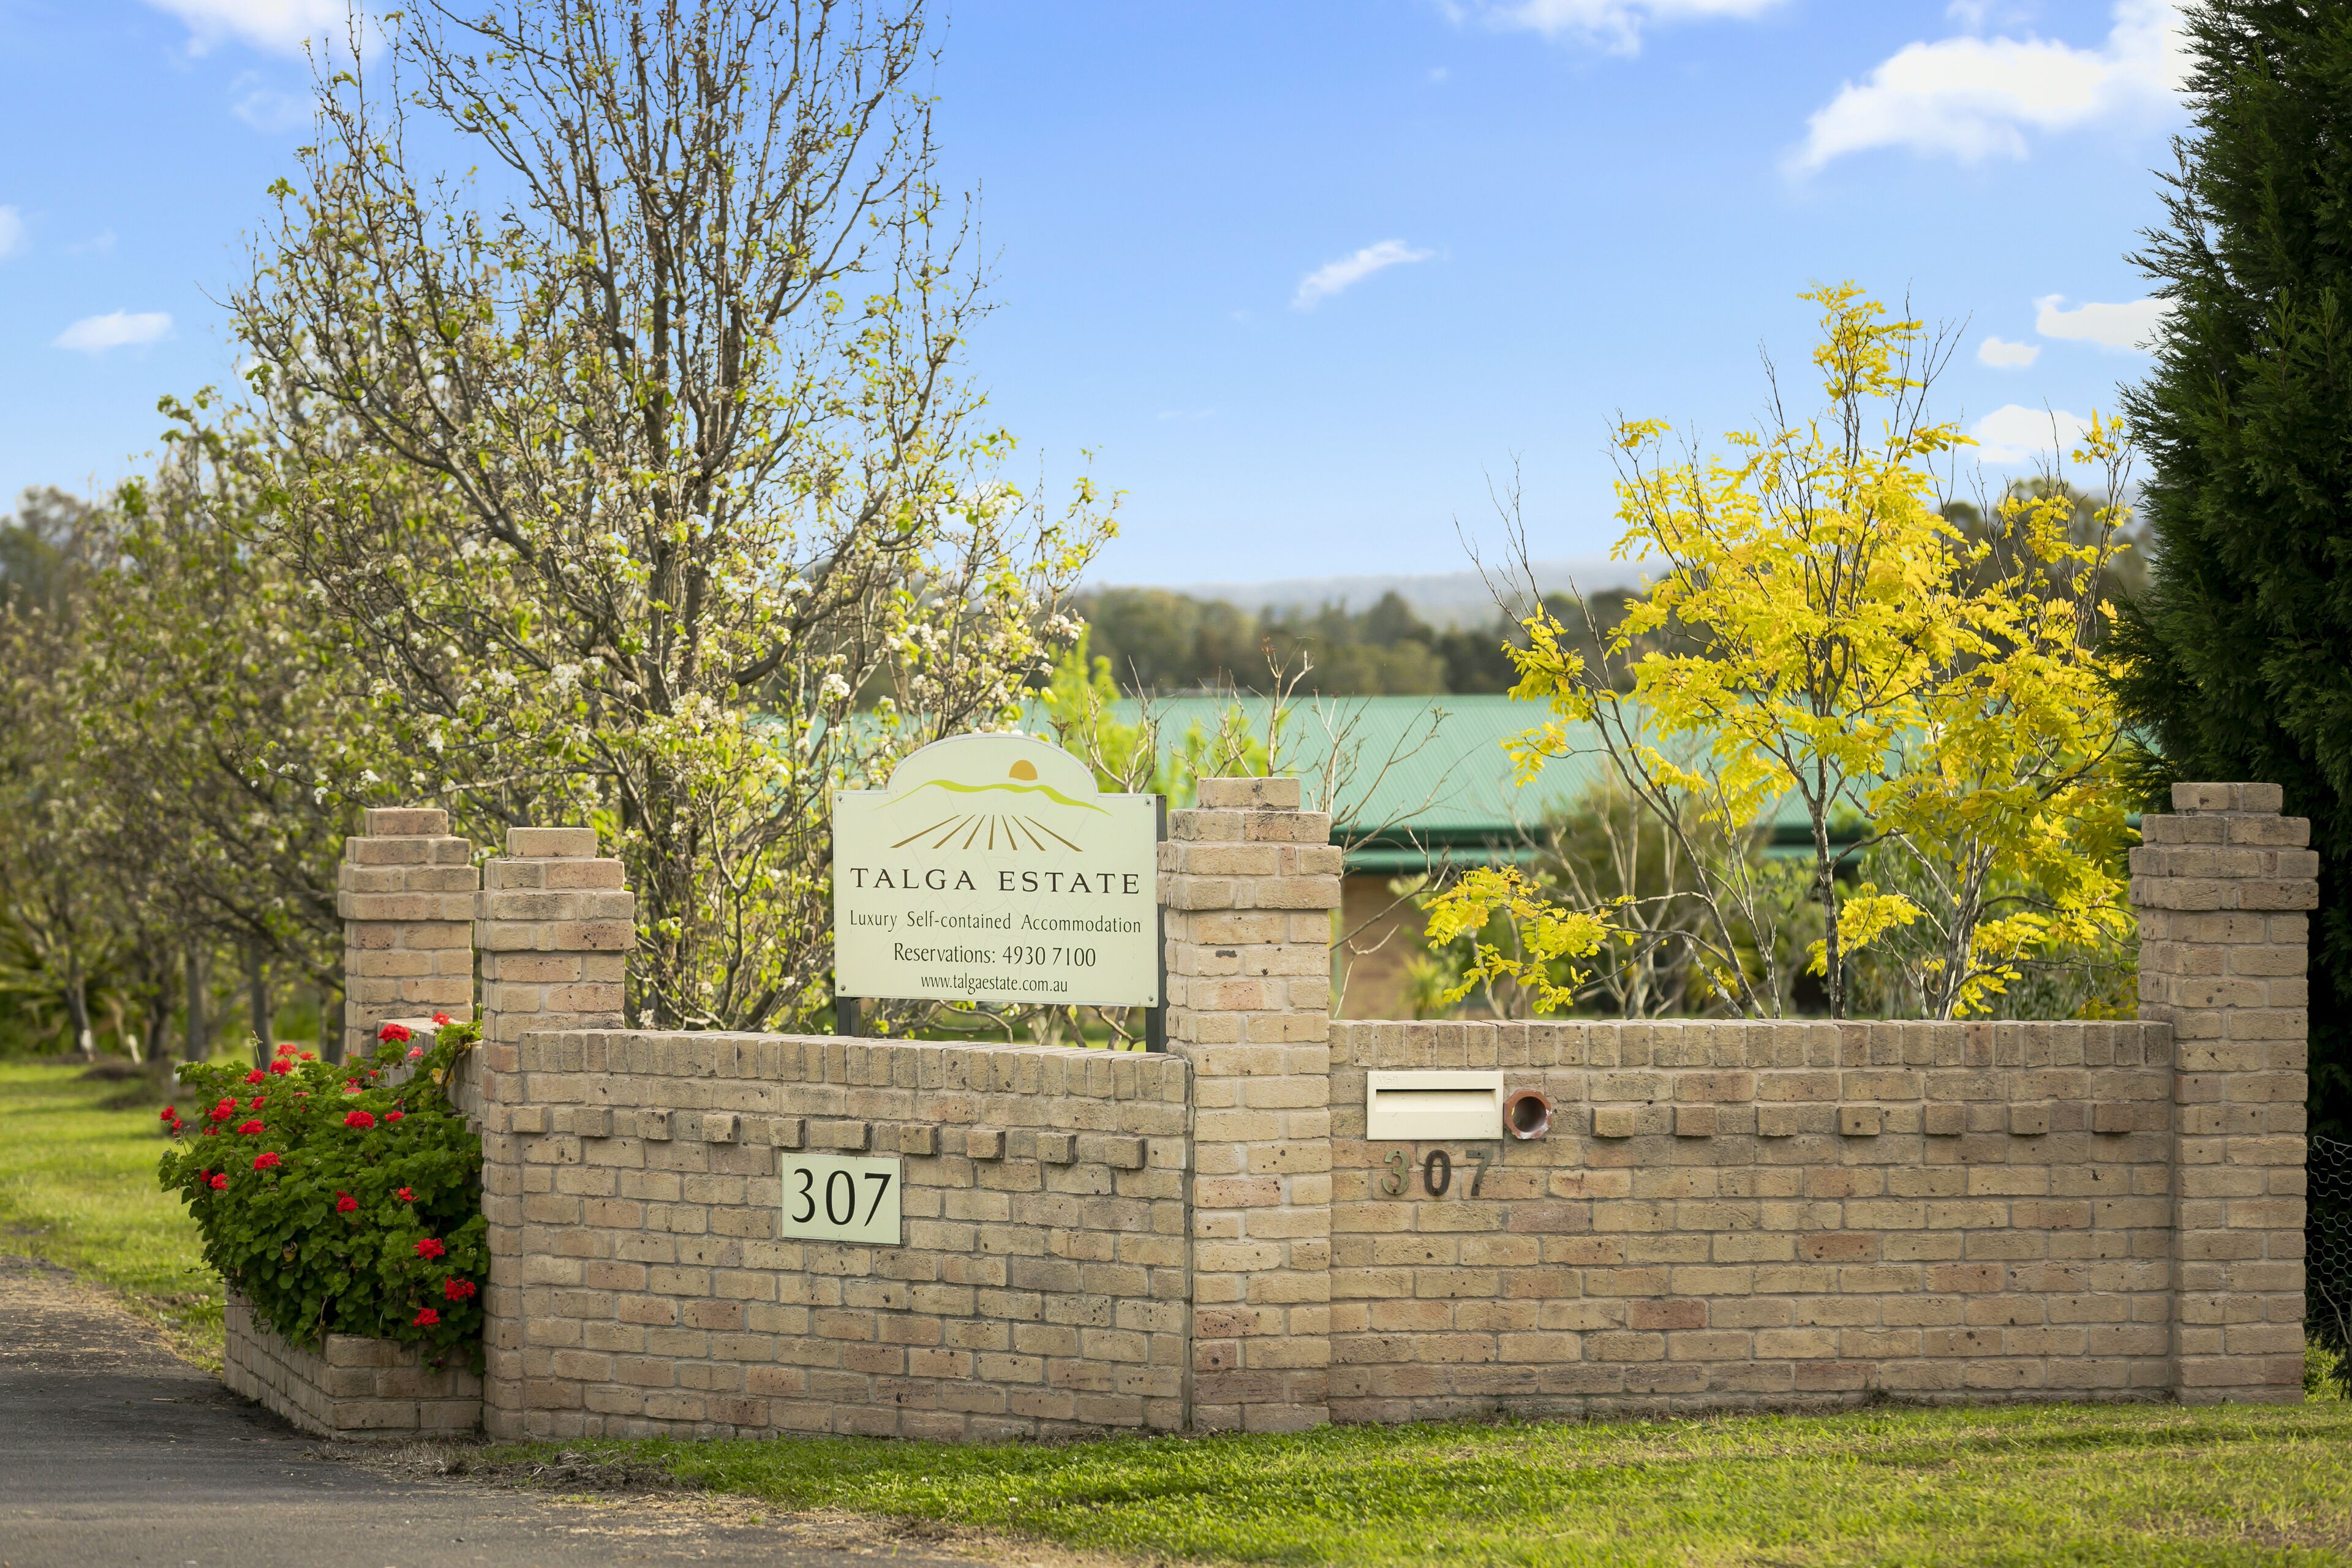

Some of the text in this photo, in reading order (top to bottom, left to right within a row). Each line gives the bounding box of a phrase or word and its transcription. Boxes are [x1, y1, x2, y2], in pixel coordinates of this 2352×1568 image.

[850, 867, 1140, 894] TALGA ESTATE
[850, 910, 1141, 933] Luxury Self-contained Accommodation
[894, 943, 1096, 967] Reservations: 4930 7100
[921, 973, 1068, 995] www.talgaestate.com.au
[1376, 1076, 1399, 1087] Mail
[791, 1168, 892, 1227] 307
